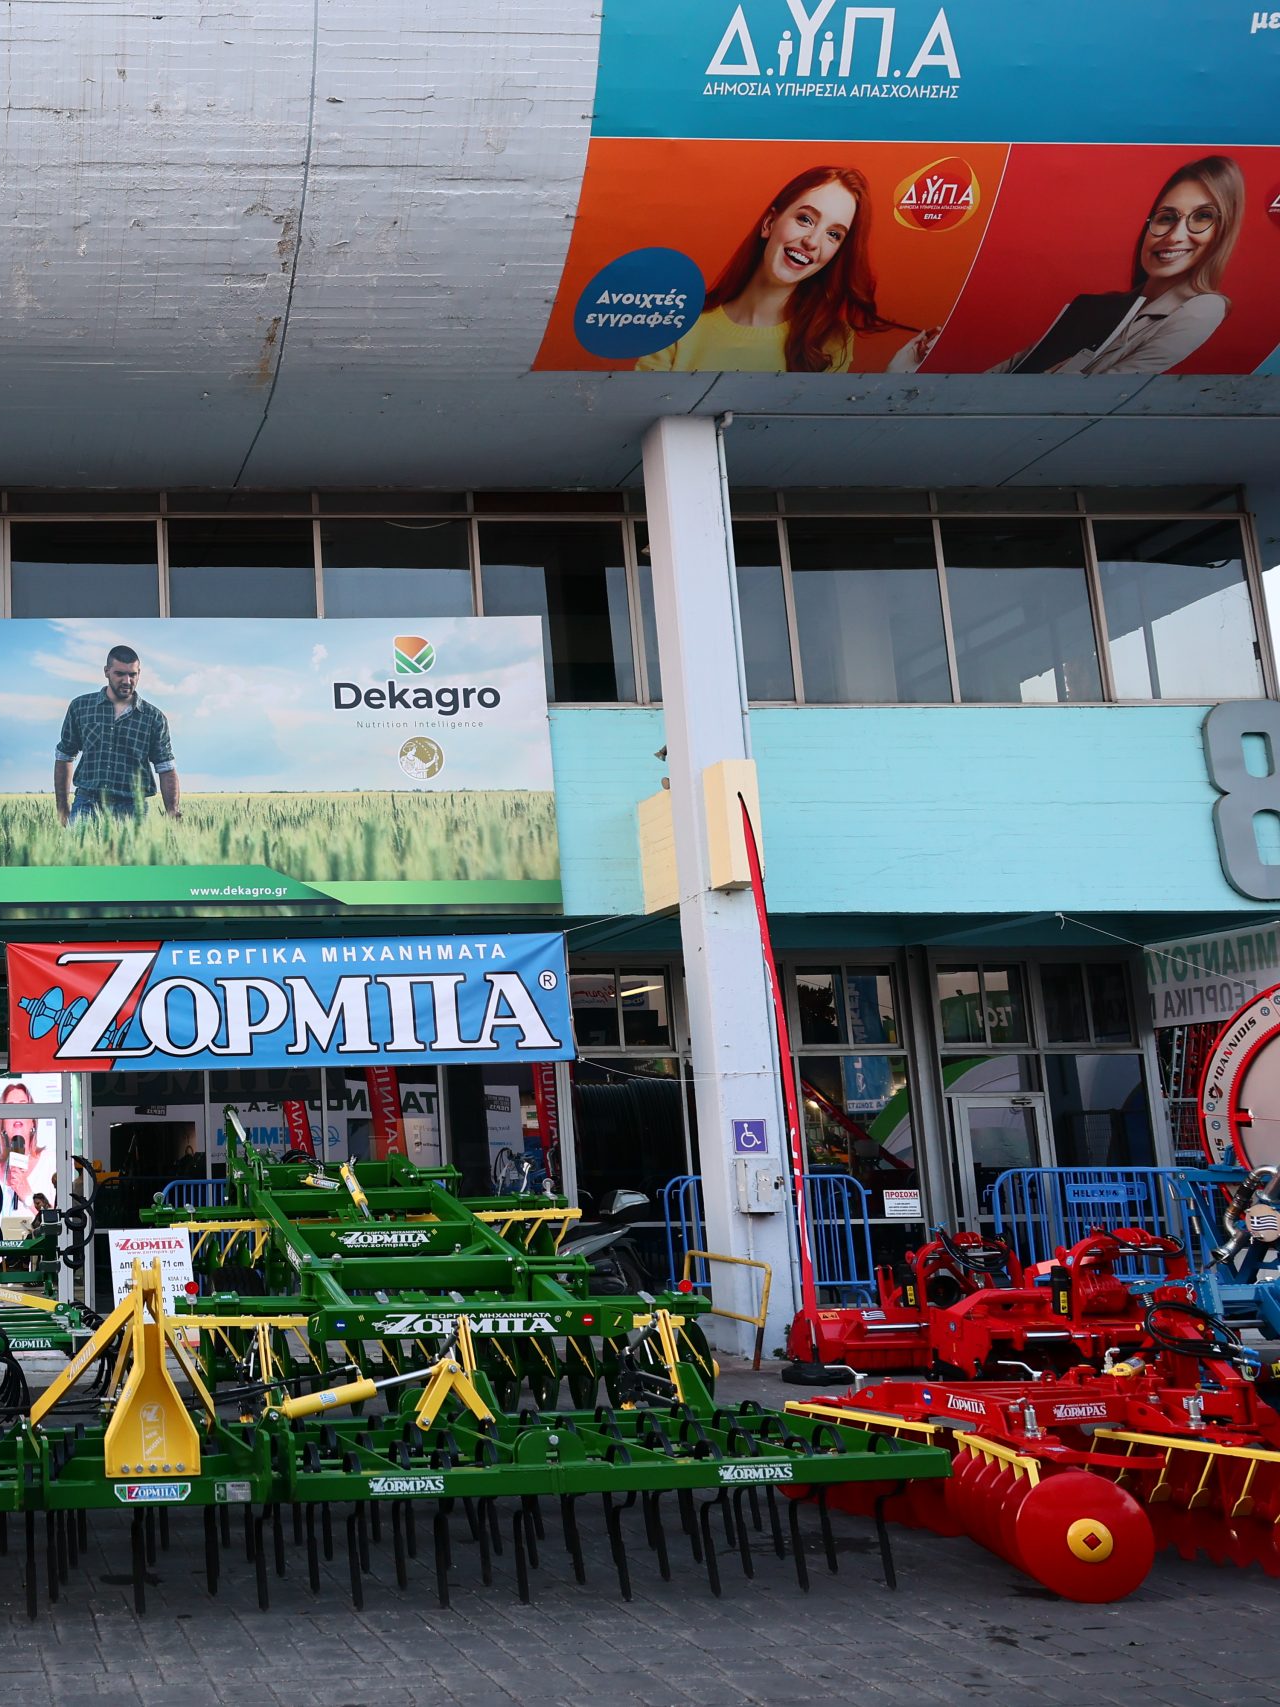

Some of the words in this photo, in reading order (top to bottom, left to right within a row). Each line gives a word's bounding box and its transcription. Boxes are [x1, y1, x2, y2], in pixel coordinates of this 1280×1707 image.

[703, 82, 771, 96] ΔΗΜΟΣΙΑ
[775, 83, 847, 97] ΥΠΗΡΕΣΙΑ
[850, 84, 959, 98] ΑΠΑΣΧΟΛΗΣΗΣ
[596, 289, 687, 309] Ανοιχτές
[586, 310, 686, 328] εγγραφές
[333, 681, 501, 716] Dekagro
[357, 721, 408, 729] Nutrition
[414, 720, 484, 730] Intelligence
[1201, 699, 1280, 900] 8
[190, 886, 288, 897] www.dekagro.gr
[172, 947, 305, 966] ΓΕΩΡΓΙΚΑ
[321, 943, 506, 963] ΜΗΧΑΝΗΜΑΤΑ
[56, 950, 562, 1058] ΖΟΡΜΠΑ
[118, 1239, 184, 1251] ΖΟΡΜΠΑ
[344, 1232, 430, 1245] ΖΟΡΜΠΑ
[9, 1338, 52, 1349] ΖΟΡΜΠΑ
[946, 1394, 986, 1414] ΖΟΡΜΠΑ
[1055, 1404, 1107, 1418] ZORMPAS
[722, 1465, 793, 1480] ZORMPAS
[372, 1477, 445, 1492] ZORMPAS
[131, 1485, 177, 1500] ΖΟΡΜΠΑ
